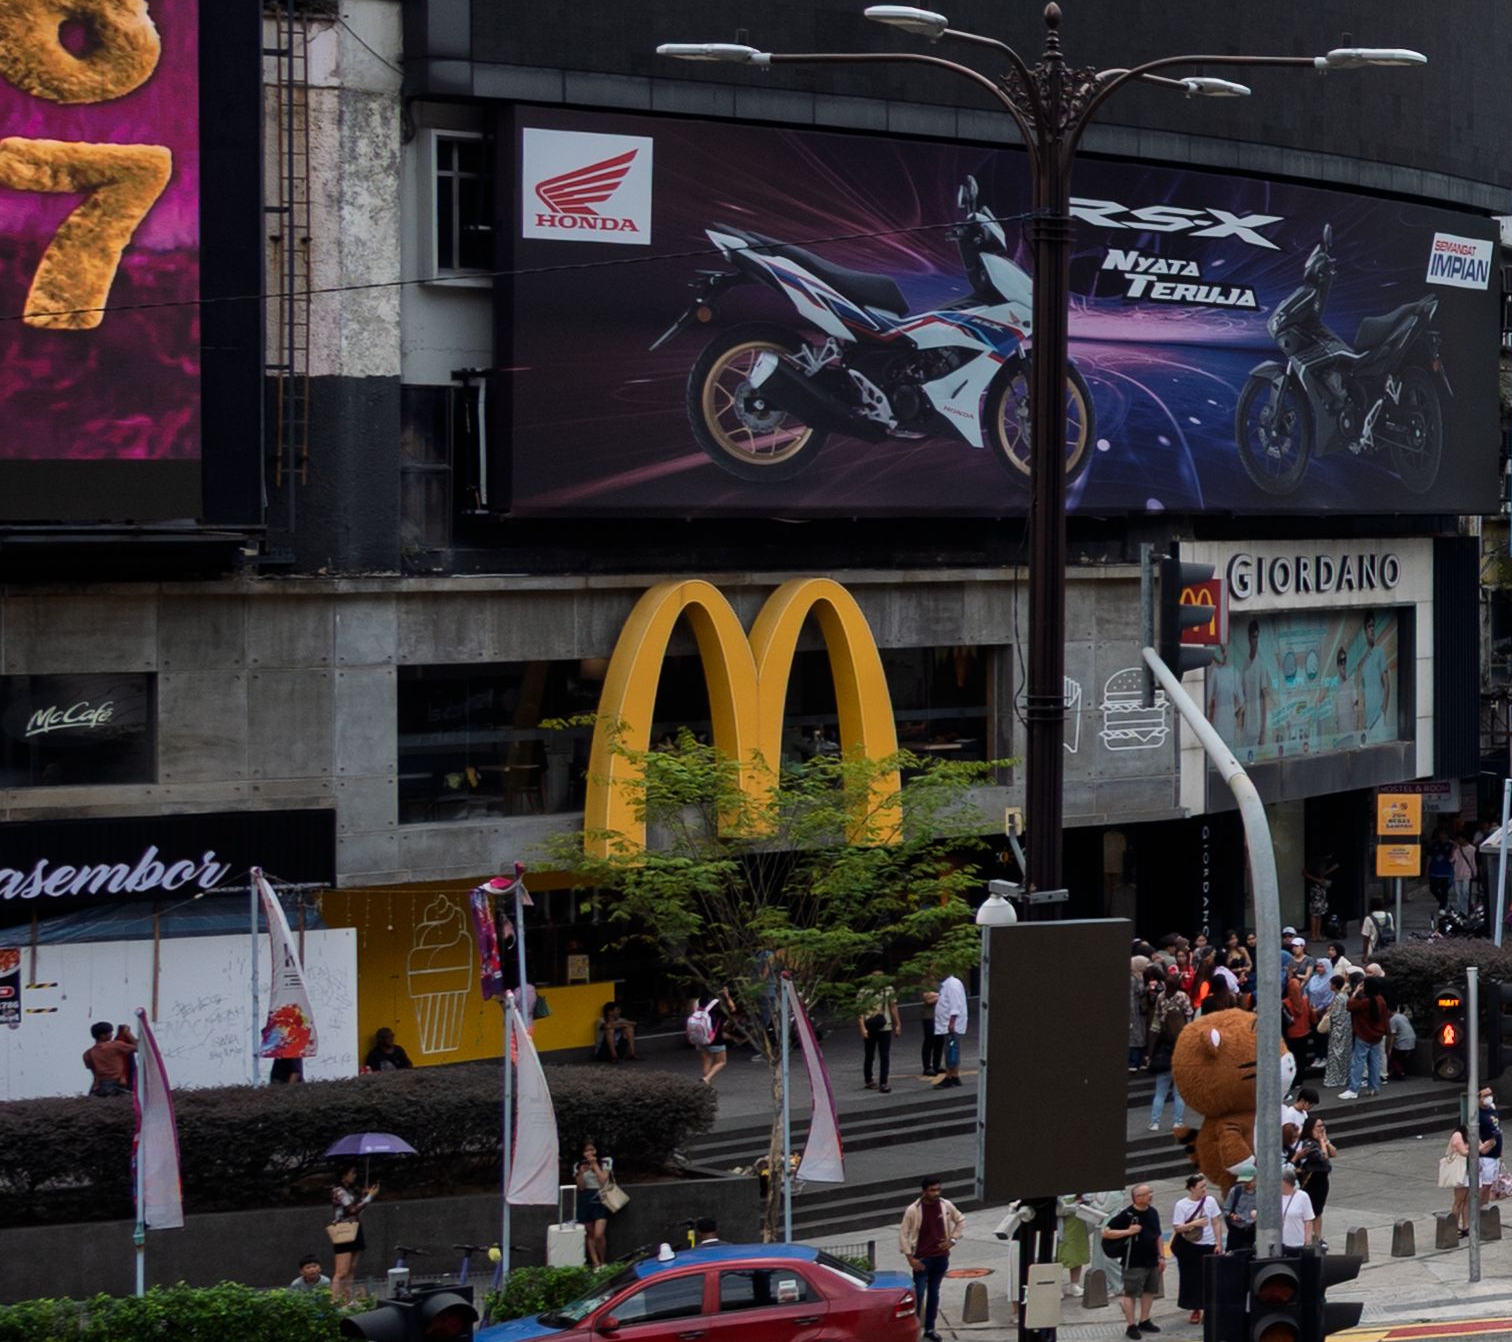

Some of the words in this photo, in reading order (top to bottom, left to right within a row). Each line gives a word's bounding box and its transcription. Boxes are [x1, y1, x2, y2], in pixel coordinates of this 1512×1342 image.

[535, 212, 640, 234] HONDA
[1434, 239, 1477, 257] SEMANGAT
[1430, 254, 1489, 284] IMPIAN
[943, 405, 975, 420] HONDA
[1227, 552, 1401, 600] GIORDANO
